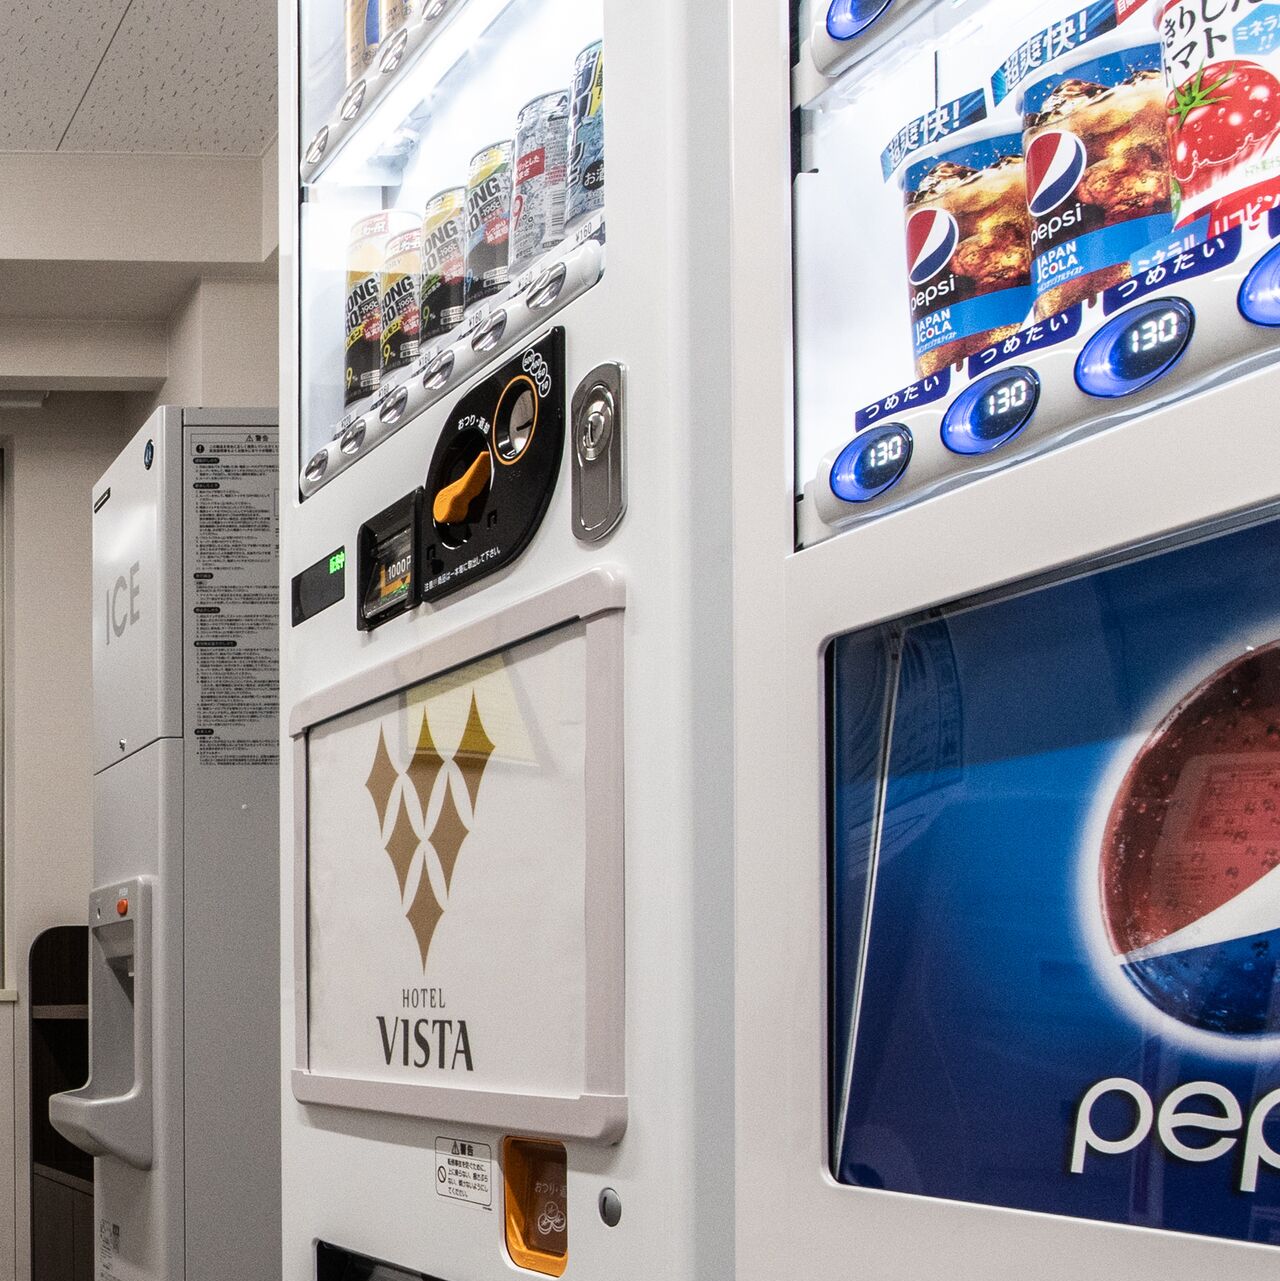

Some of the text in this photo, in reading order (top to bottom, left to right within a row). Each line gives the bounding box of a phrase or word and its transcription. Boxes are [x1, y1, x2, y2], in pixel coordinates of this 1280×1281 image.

[1003, 10, 1088, 94] 超爽快!
[889, 100, 961, 165] 超爽快!
[1030, 203, 1082, 250] pepsi
[1118, 236, 1226, 298] つめたい
[911, 274, 956, 316] pepsi
[981, 313, 1069, 364] つめたい
[1131, 311, 1178, 354] 130
[865, 376, 940, 420] つめたい
[989, 379, 1026, 416] 130
[457, 414, 491, 435] おつり・返却
[870, 436, 902, 468] 130
[105, 561, 142, 646] ICE
[402, 988, 446, 1009] HOTEL
[376, 1016, 474, 1072] VISTA
